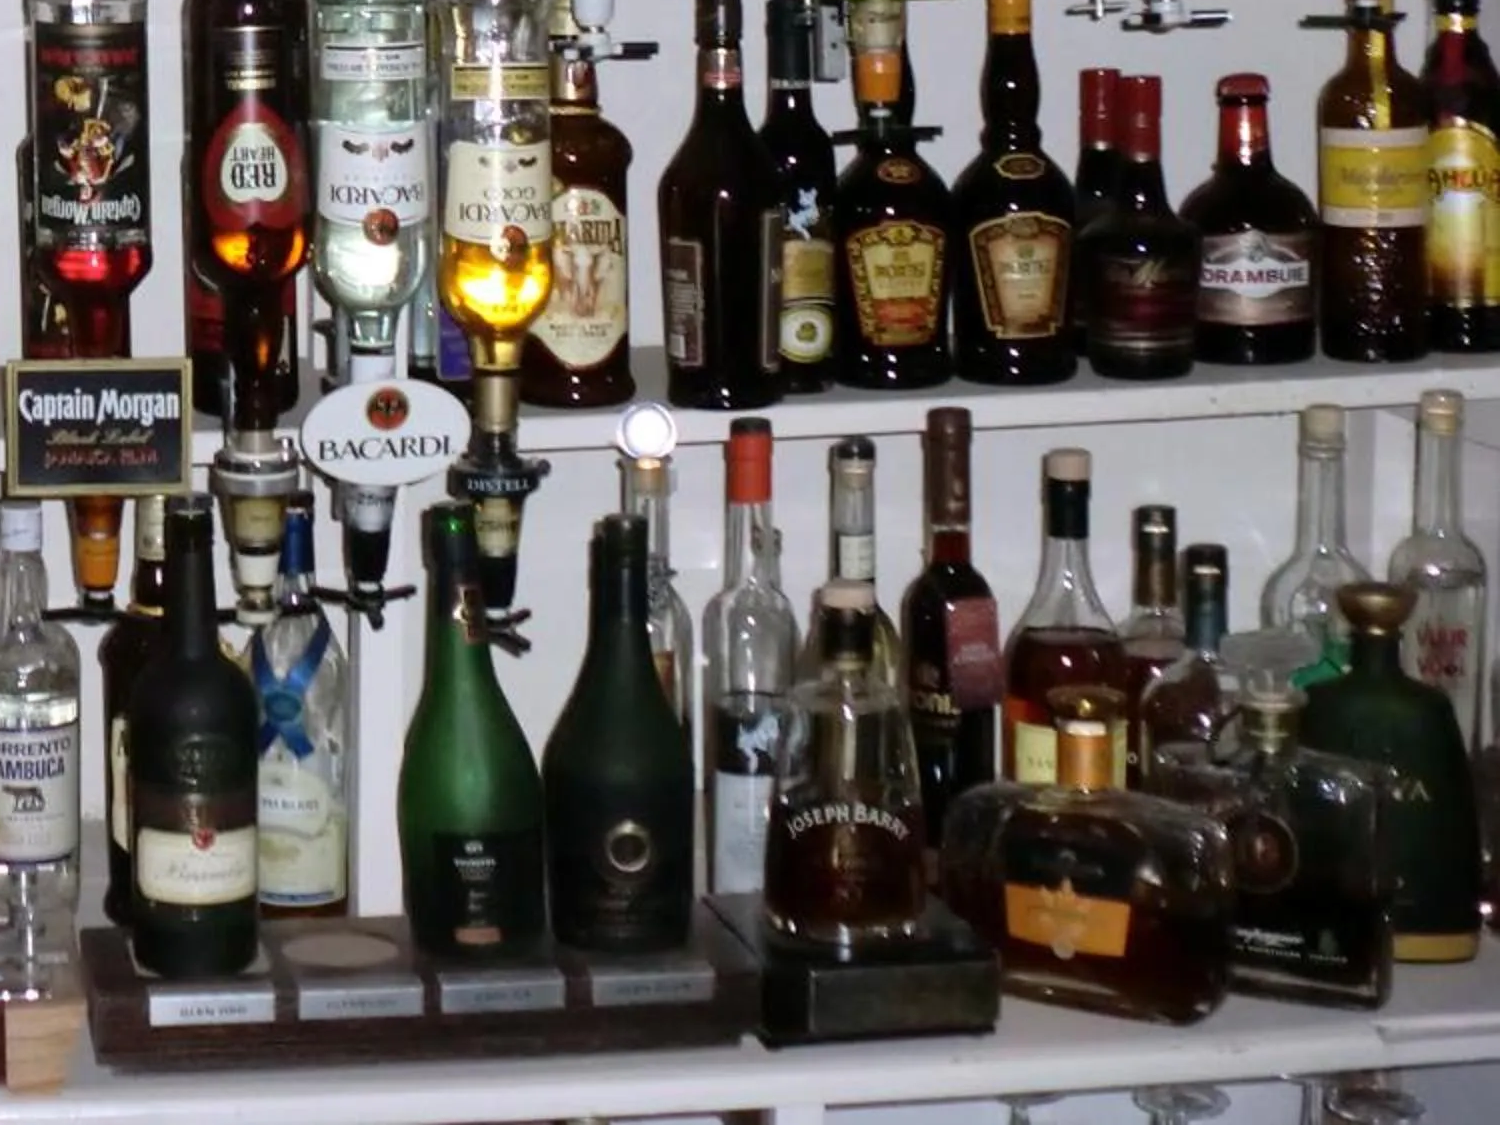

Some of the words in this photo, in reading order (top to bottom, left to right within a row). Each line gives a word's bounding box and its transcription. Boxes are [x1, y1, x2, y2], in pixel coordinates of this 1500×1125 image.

[230, 166, 277, 189] RED
[41, 193, 90, 226] Morgan
[91, 193, 141, 225] Captain
[329, 184, 424, 206] BACARDI
[1201, 264, 1309, 285] DRAMBUIE
[17, 388, 95, 427] Captain
[97, 387, 181, 426] Morgan
[318, 435, 451, 462] BACARDI
[786, 803, 851, 841] JOSEPH
[851, 801, 911, 841] BARRY
